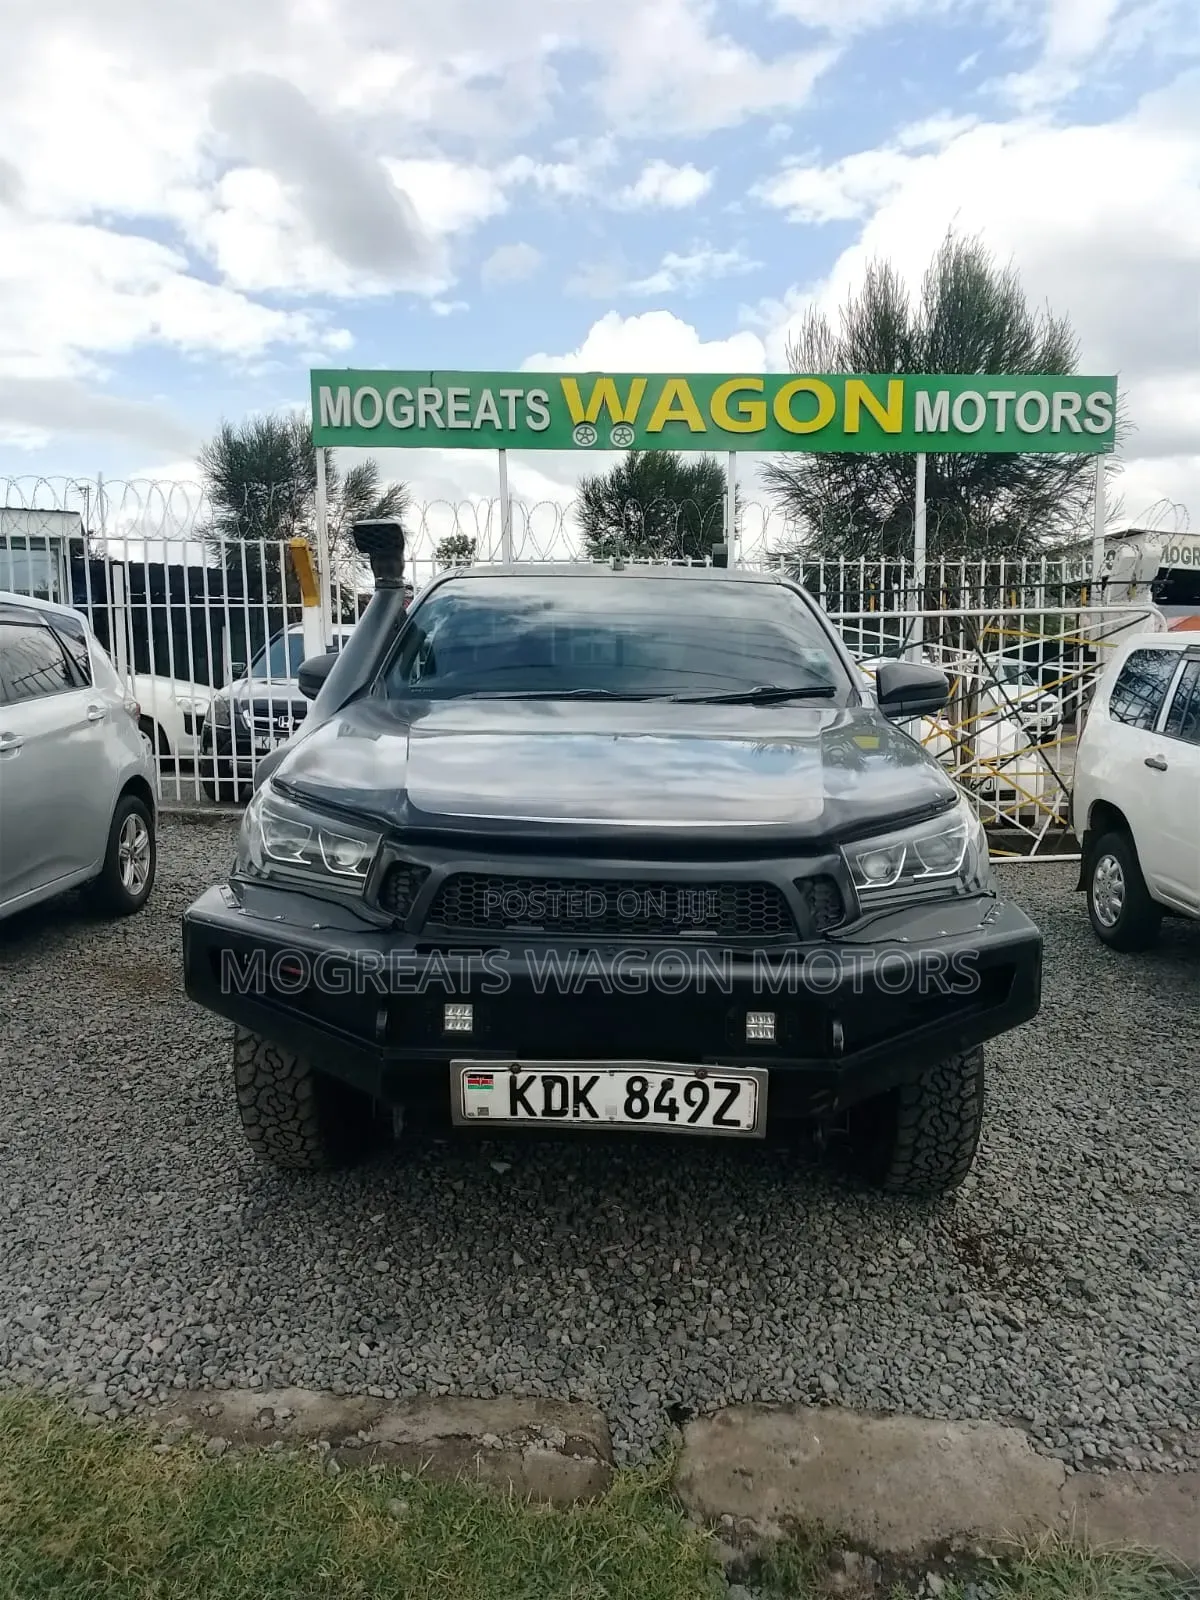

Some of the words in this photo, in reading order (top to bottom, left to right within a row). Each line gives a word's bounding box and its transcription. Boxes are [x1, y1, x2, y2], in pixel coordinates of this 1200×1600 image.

[319, 385, 551, 431] MOGREATS
[560, 377, 904, 433] WAGON
[914, 390, 1113, 434] MOTORS
[509, 1074, 600, 1118] KDK
[623, 1075, 741, 1127] 849Z
